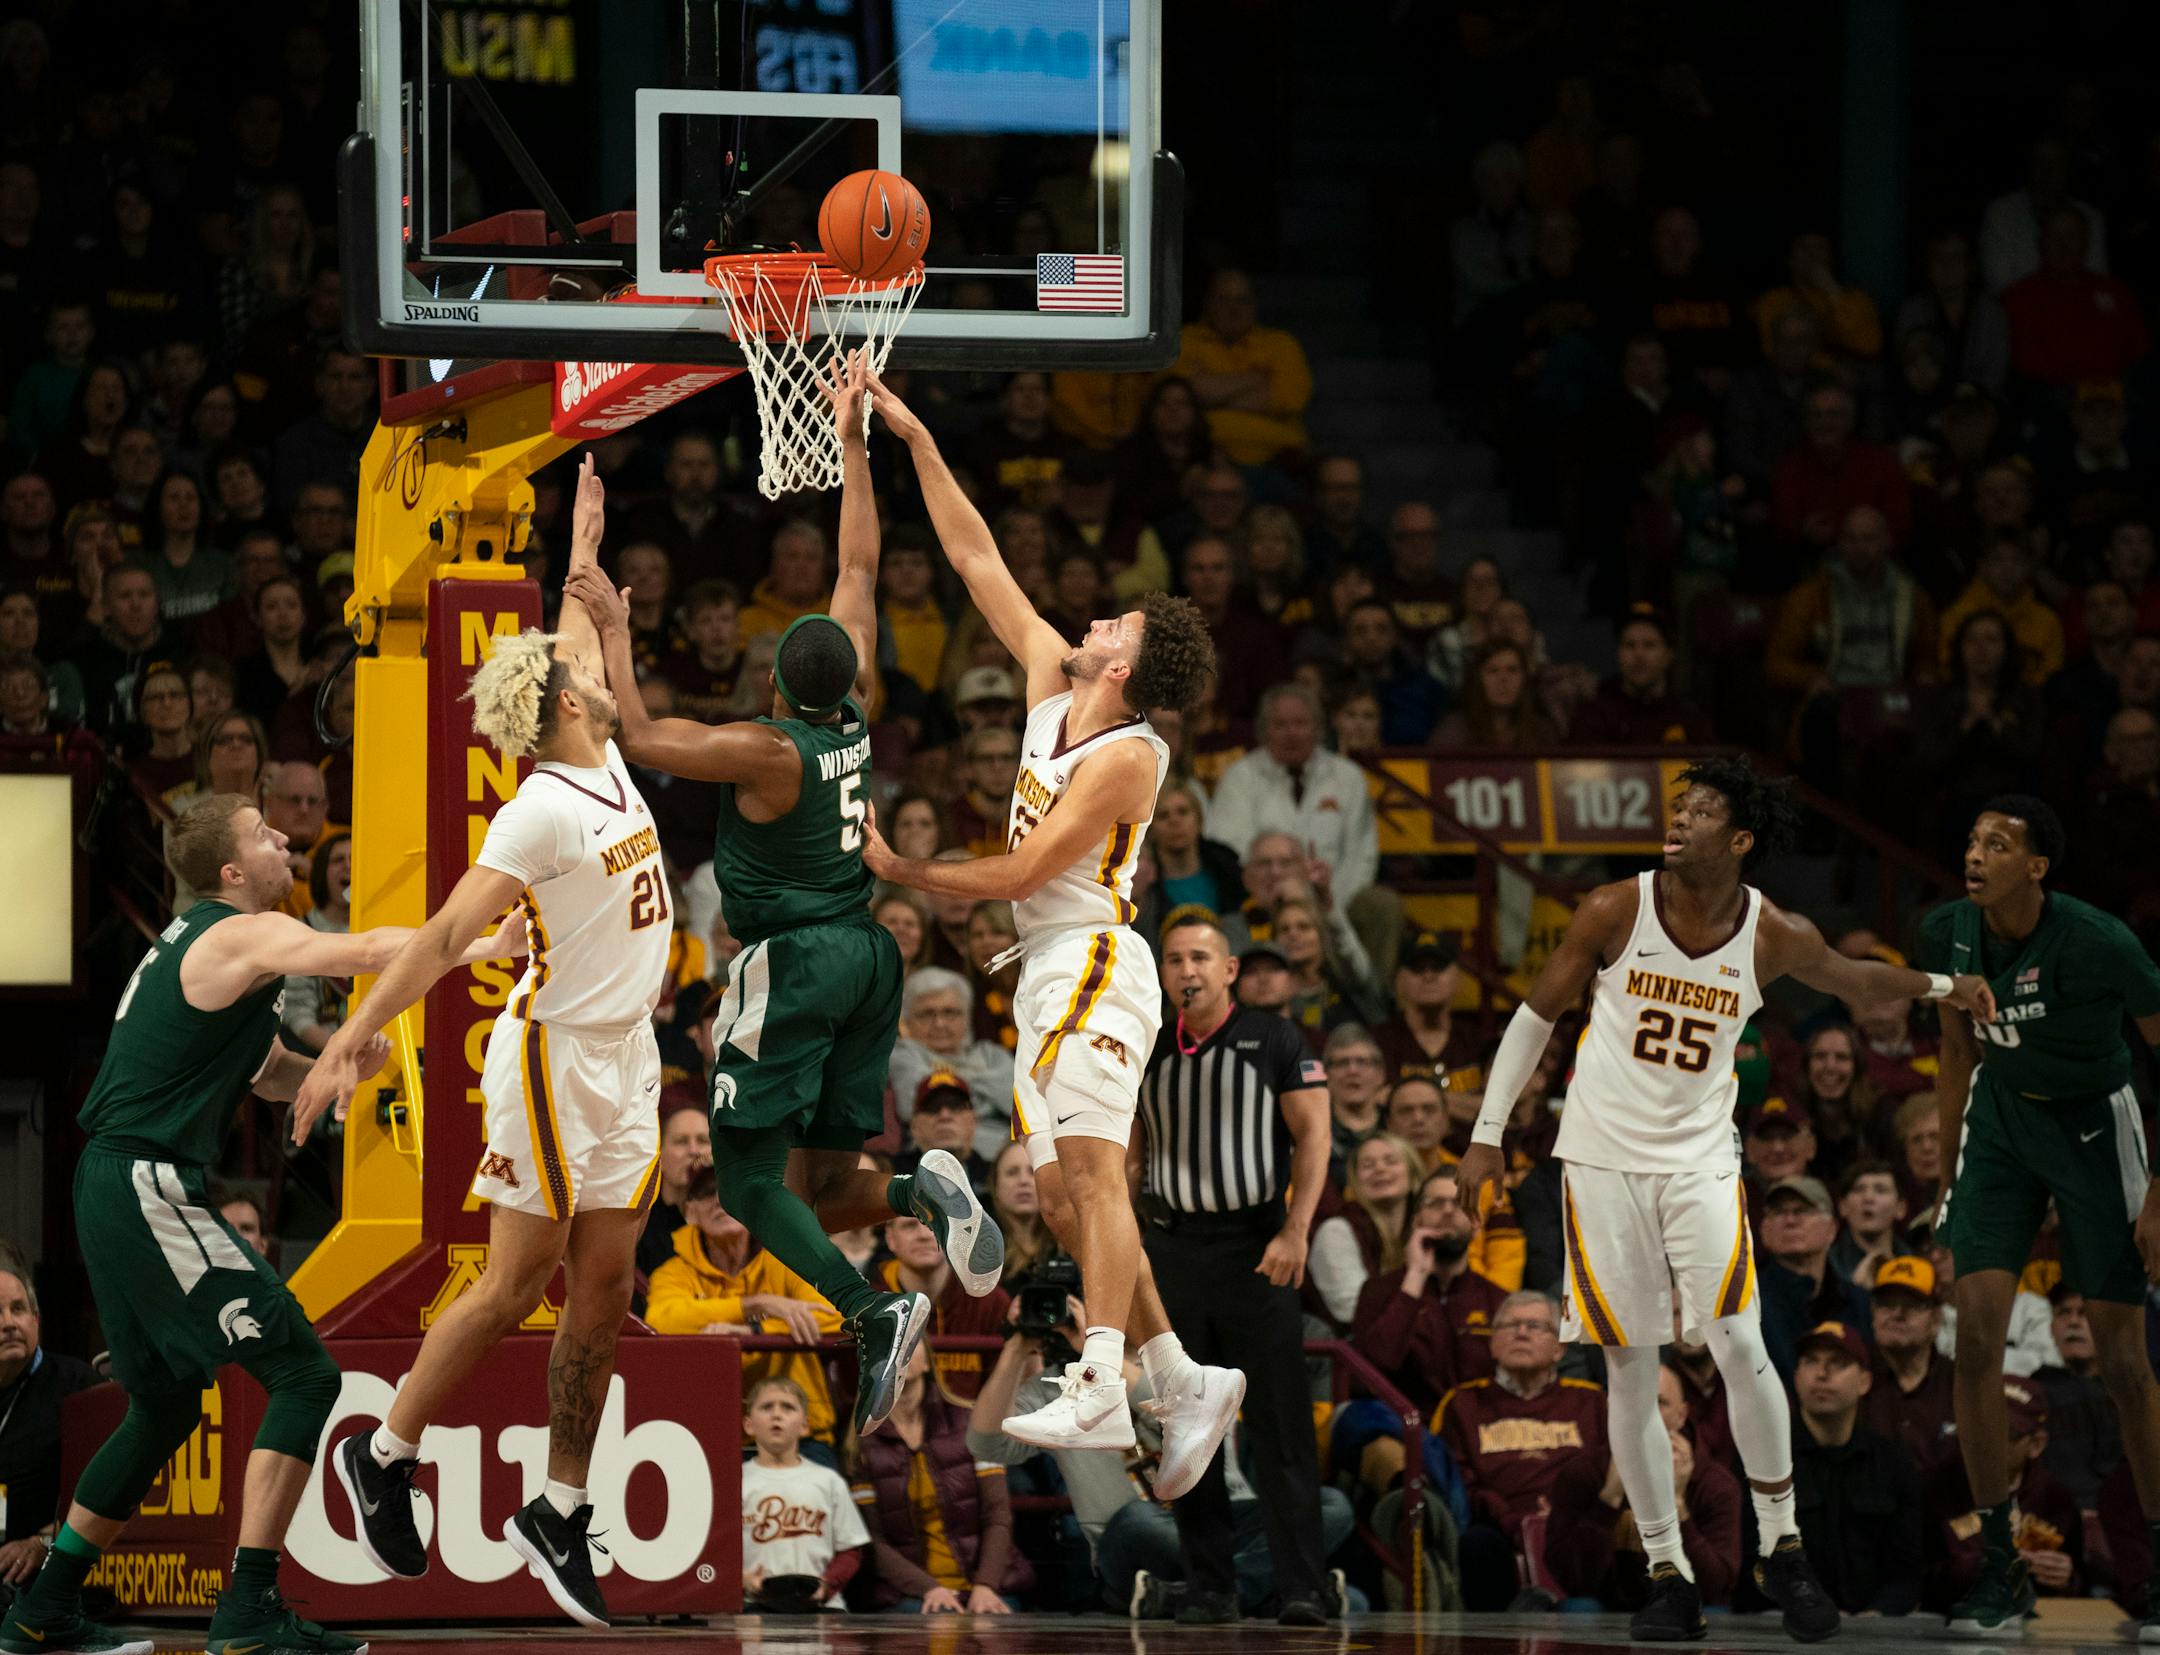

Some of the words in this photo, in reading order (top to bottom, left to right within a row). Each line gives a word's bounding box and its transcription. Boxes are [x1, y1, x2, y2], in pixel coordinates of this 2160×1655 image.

[404, 304, 480, 323] SPALDING
[839, 772, 867, 853] 5
[1444, 776, 1528, 831] 101
[1567, 779, 1656, 830] 102
[628, 863, 669, 932] 21
[1625, 968, 1741, 1019] MINNESOTA
[1632, 1007, 1713, 1074] 25
[283, 1371, 714, 1585] Cub
[752, 1495, 827, 1543] Barn
